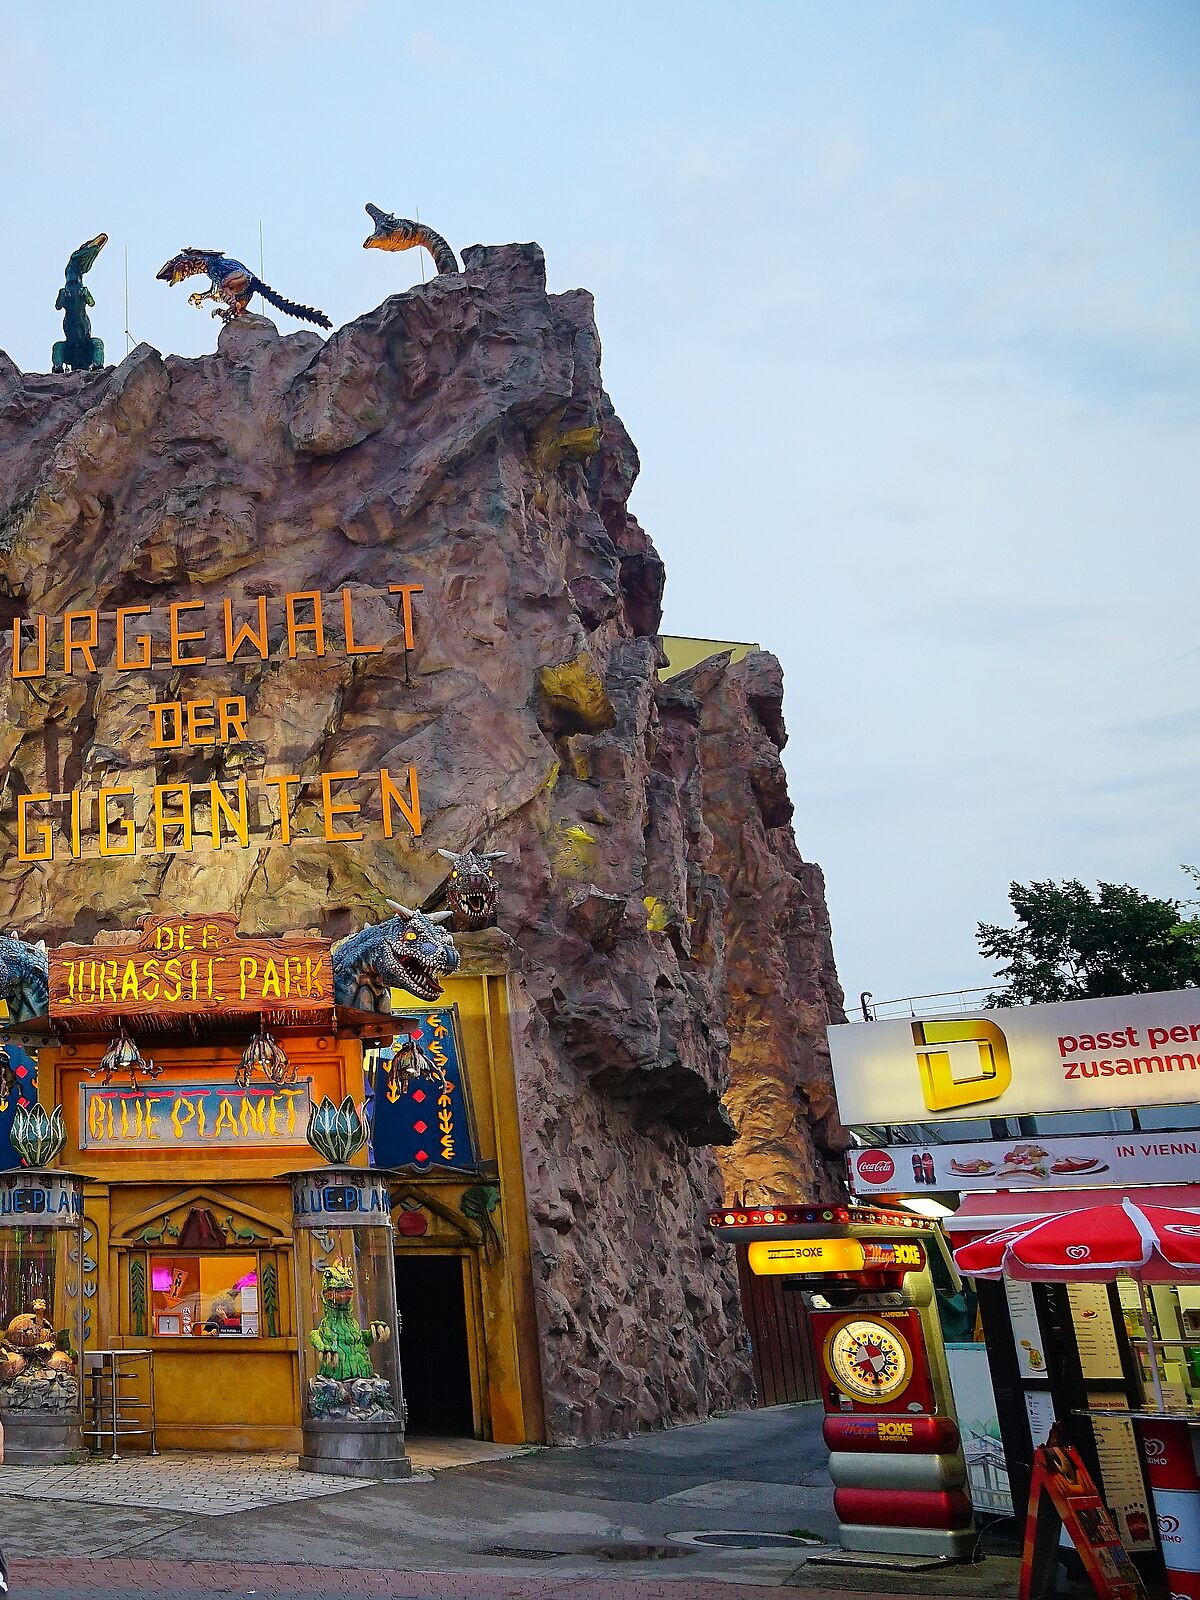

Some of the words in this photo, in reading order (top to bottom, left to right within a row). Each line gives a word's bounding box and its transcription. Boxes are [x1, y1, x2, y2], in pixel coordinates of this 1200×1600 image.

[12, 583, 424, 679] URGEWALT
[147, 695, 249, 750] DER
[16, 766, 423, 863] GIGANTEN
[155, 924, 220, 951] DER
[239, 955, 325, 1001] PARK
[1057, 1026, 1140, 1057] passt
[1062, 1052, 1200, 1080] zusamm
[88, 1093, 161, 1140] BLUE
[170, 1089, 305, 1140] PLANET
[1116, 1145, 1135, 1157] IN
[1140, 1142, 1200, 1156] VIENN
[795, 1247, 823, 1258] BOXE
[892, 1244, 921, 1265] BOXE
[877, 1422, 913, 1436] BOXE
